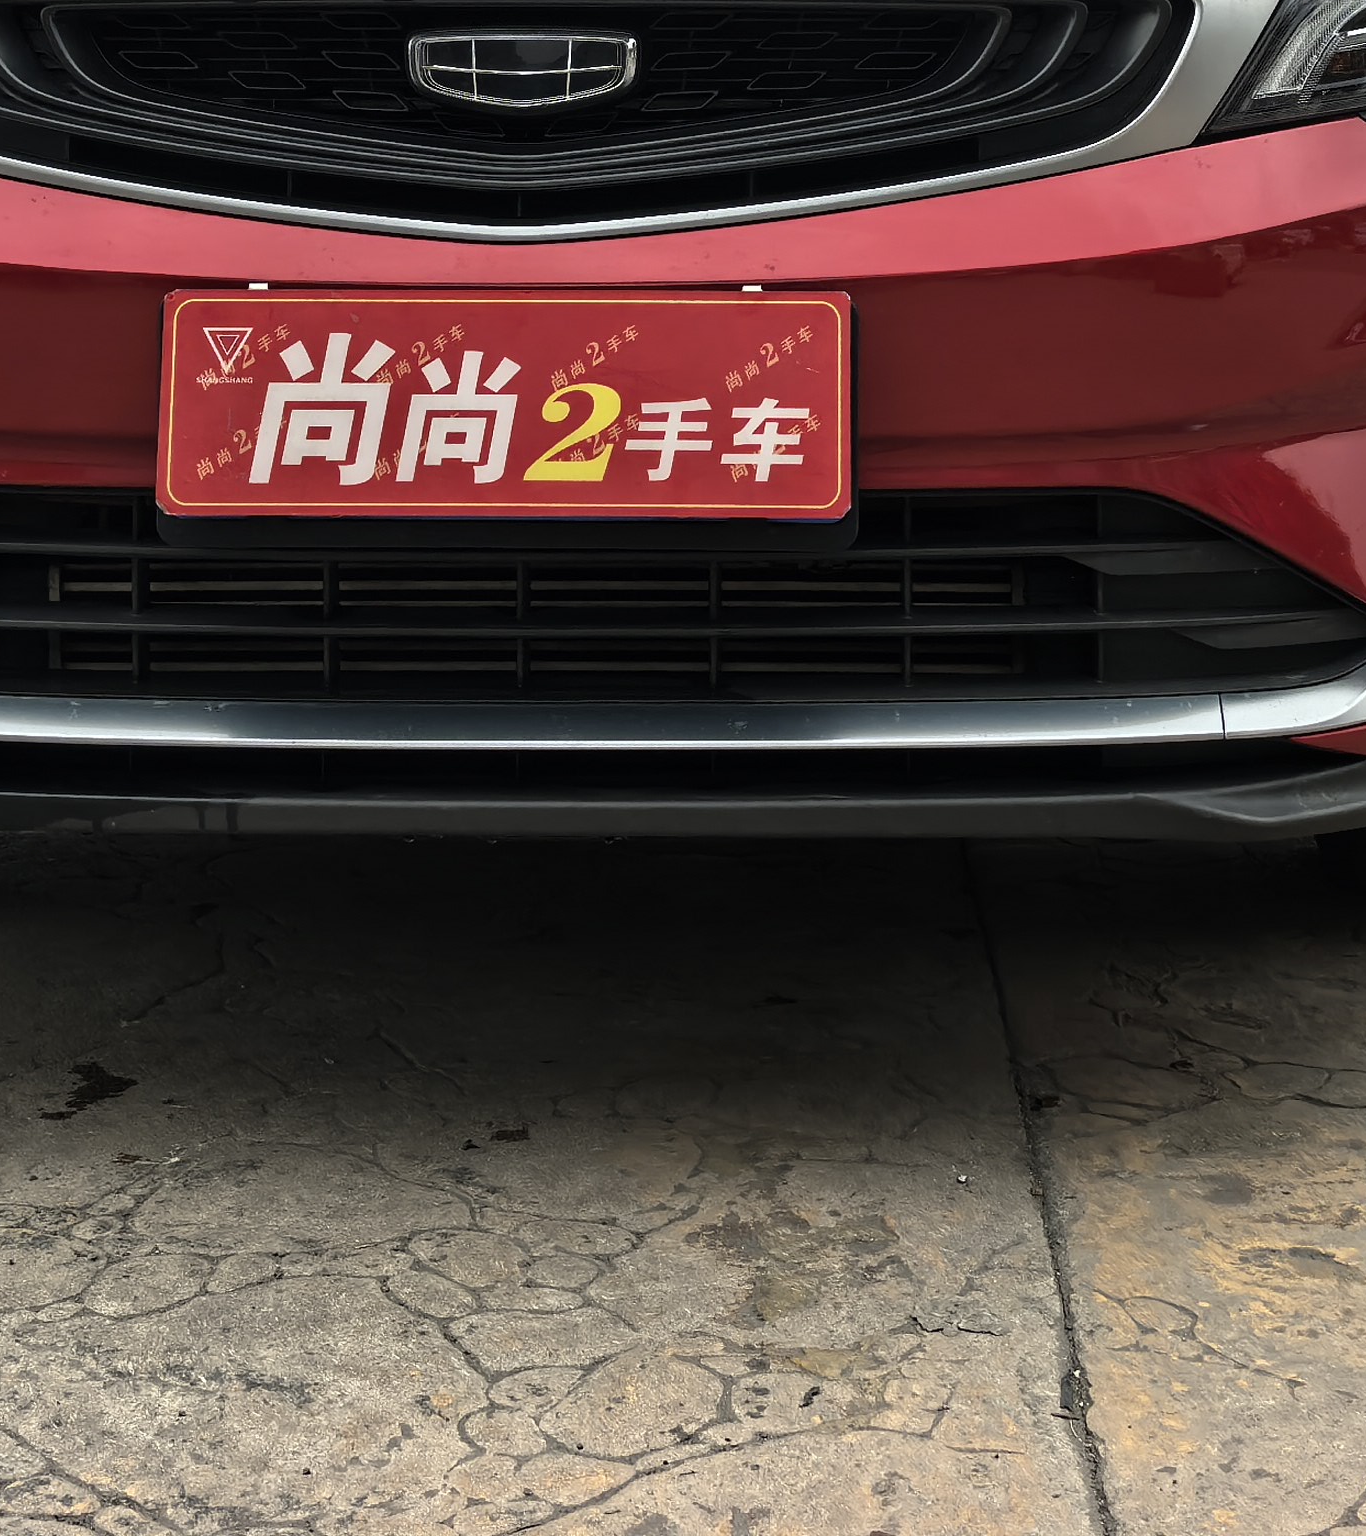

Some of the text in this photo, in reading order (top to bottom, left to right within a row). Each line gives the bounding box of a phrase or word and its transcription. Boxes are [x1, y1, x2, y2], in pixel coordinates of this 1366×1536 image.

[551, 324, 639, 392] 尚尚2手车
[725, 325, 814, 393] 尚尚2手车
[249, 332, 811, 485] 尚尚2手车
